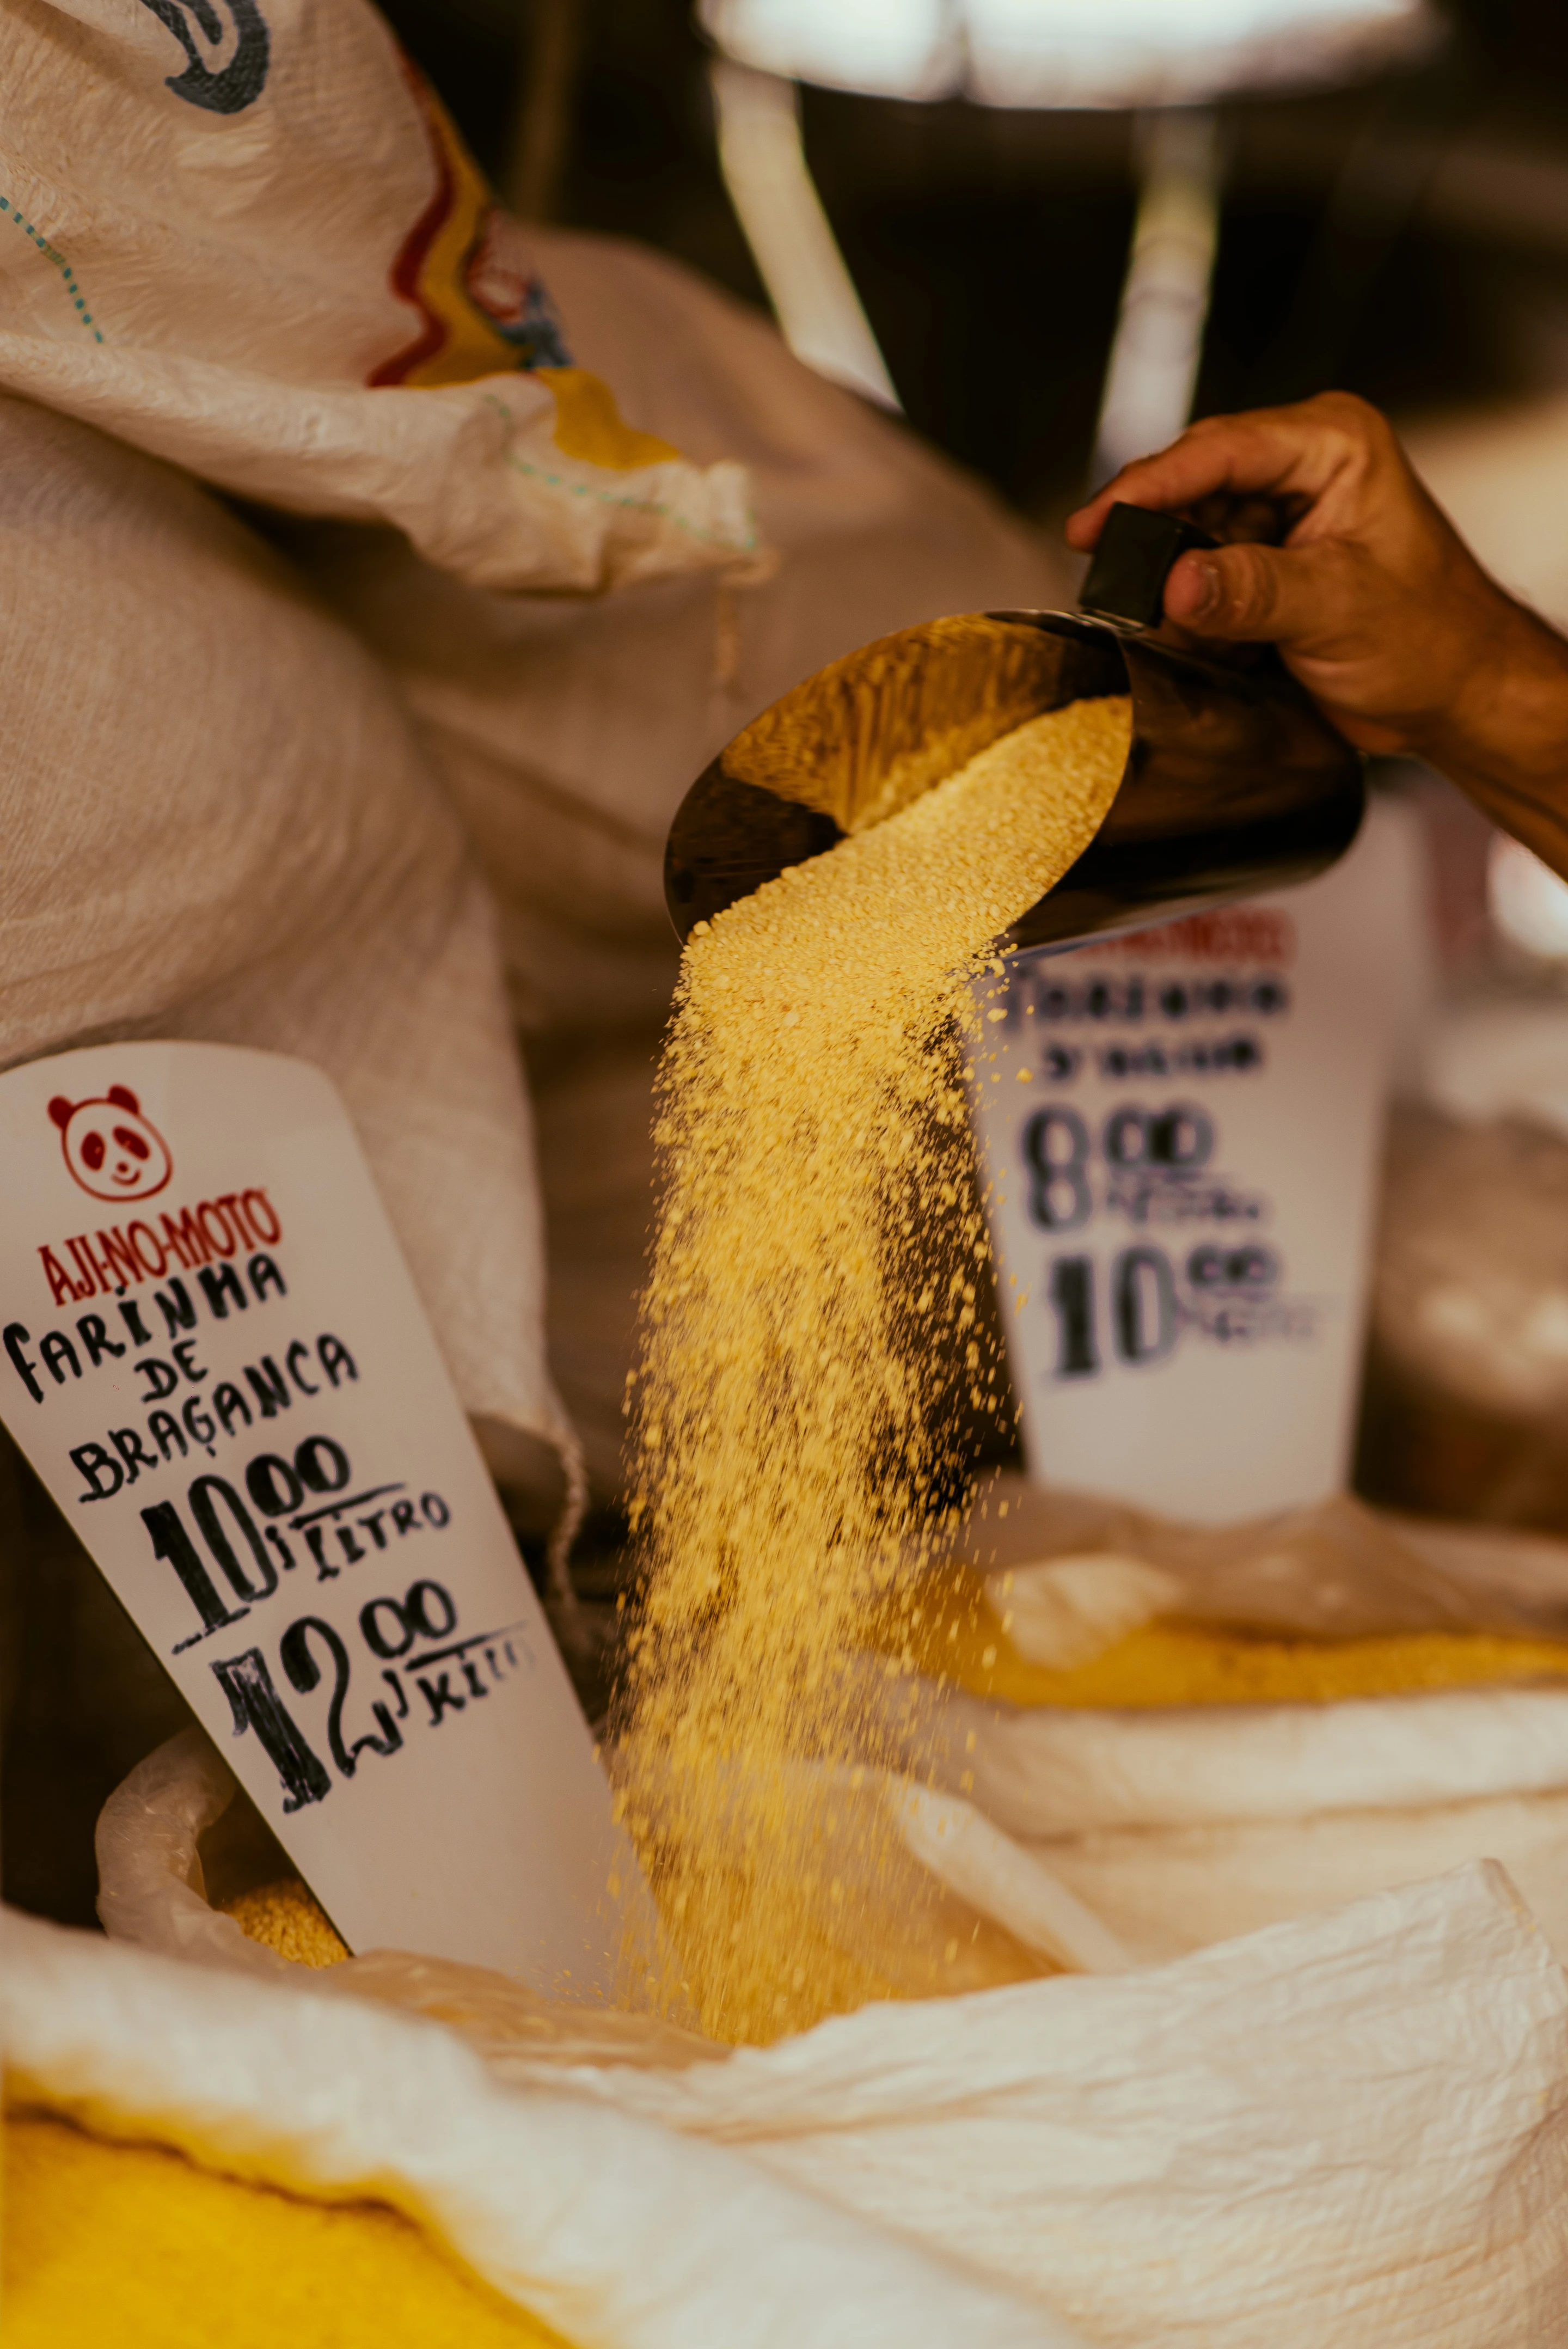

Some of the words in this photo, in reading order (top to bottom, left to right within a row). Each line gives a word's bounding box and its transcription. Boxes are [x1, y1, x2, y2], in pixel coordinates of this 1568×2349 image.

[1022, 1106, 1089, 1232] 8
[38, 1186, 281, 1306] AJI-NO-MOTO
[2, 1253, 287, 1404] FARINHA
[133, 1338, 208, 1403] DE
